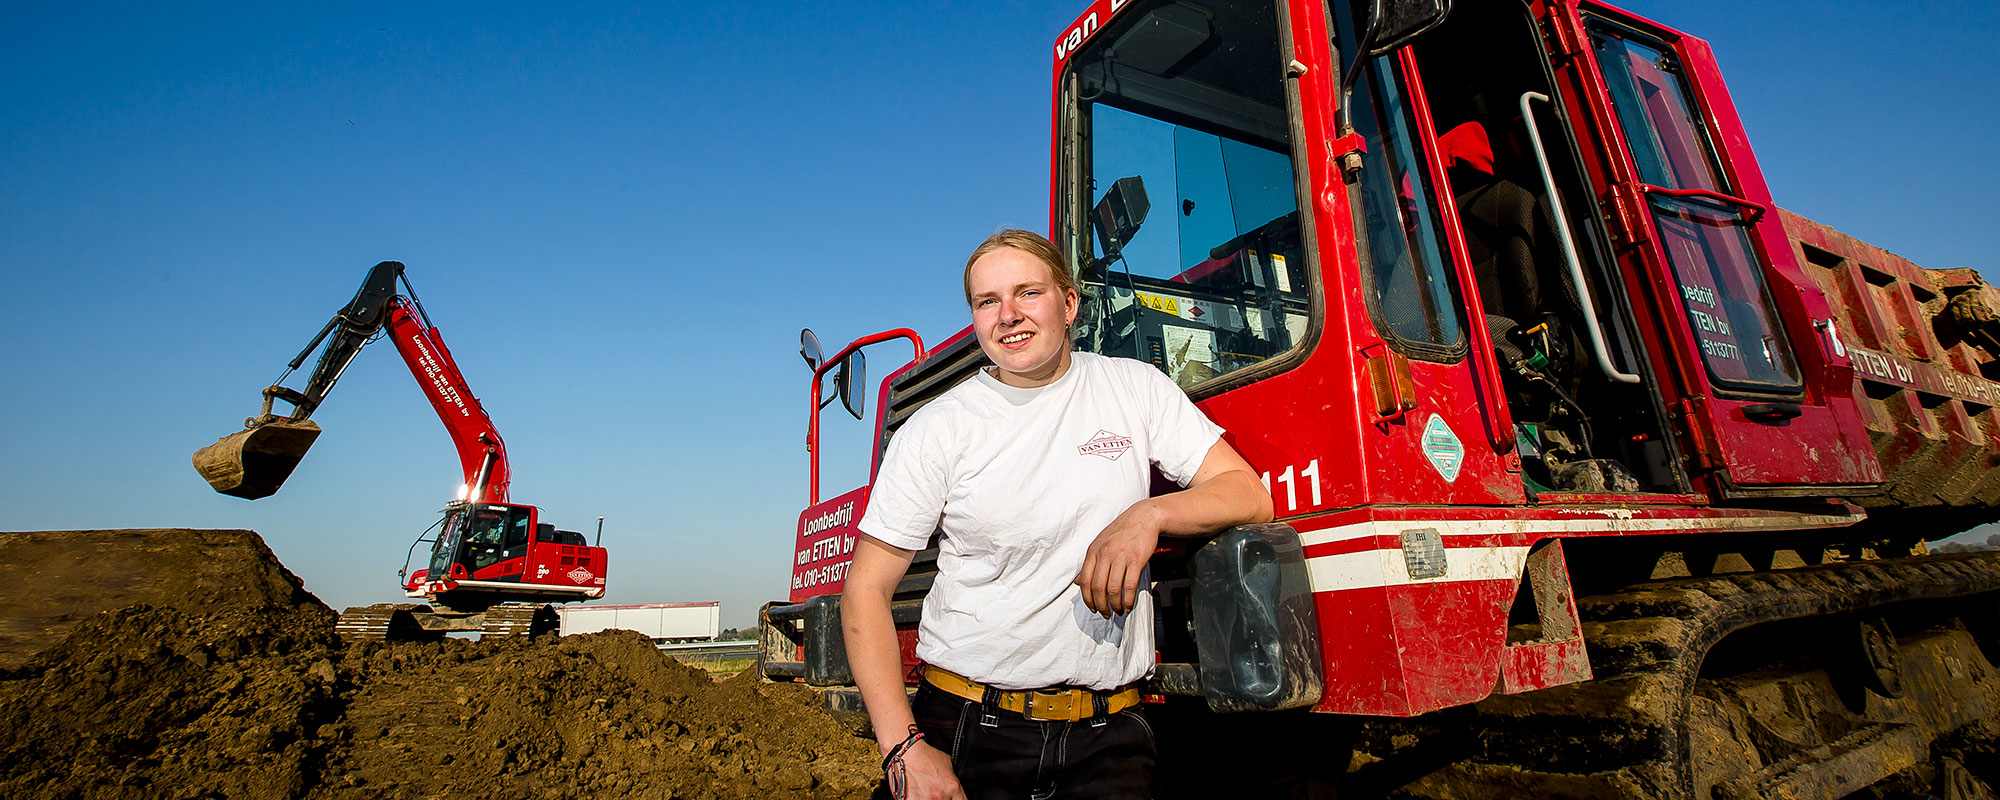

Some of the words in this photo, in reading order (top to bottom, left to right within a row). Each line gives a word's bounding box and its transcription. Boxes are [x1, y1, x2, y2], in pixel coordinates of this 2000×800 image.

[1056, 12, 1098, 60] van
[1716, 316, 1730, 335] bv
[413, 334, 441, 373] Loonbedrijf
[439, 374, 448, 386] van
[447, 386, 464, 408] ETTEN
[461, 407, 469, 416] bv
[1892, 359, 1913, 383] bv
[1081, 443, 1100, 452] VAN
[1103, 439, 1132, 448] ETTEN
[803, 501, 854, 537] Loonbedrijf
[797, 548, 811, 566] van
[812, 535, 841, 562] ETTEN
[843, 533, 855, 555] bv
[792, 572, 803, 590] tel.
[804, 560, 853, 588] 010-511377
